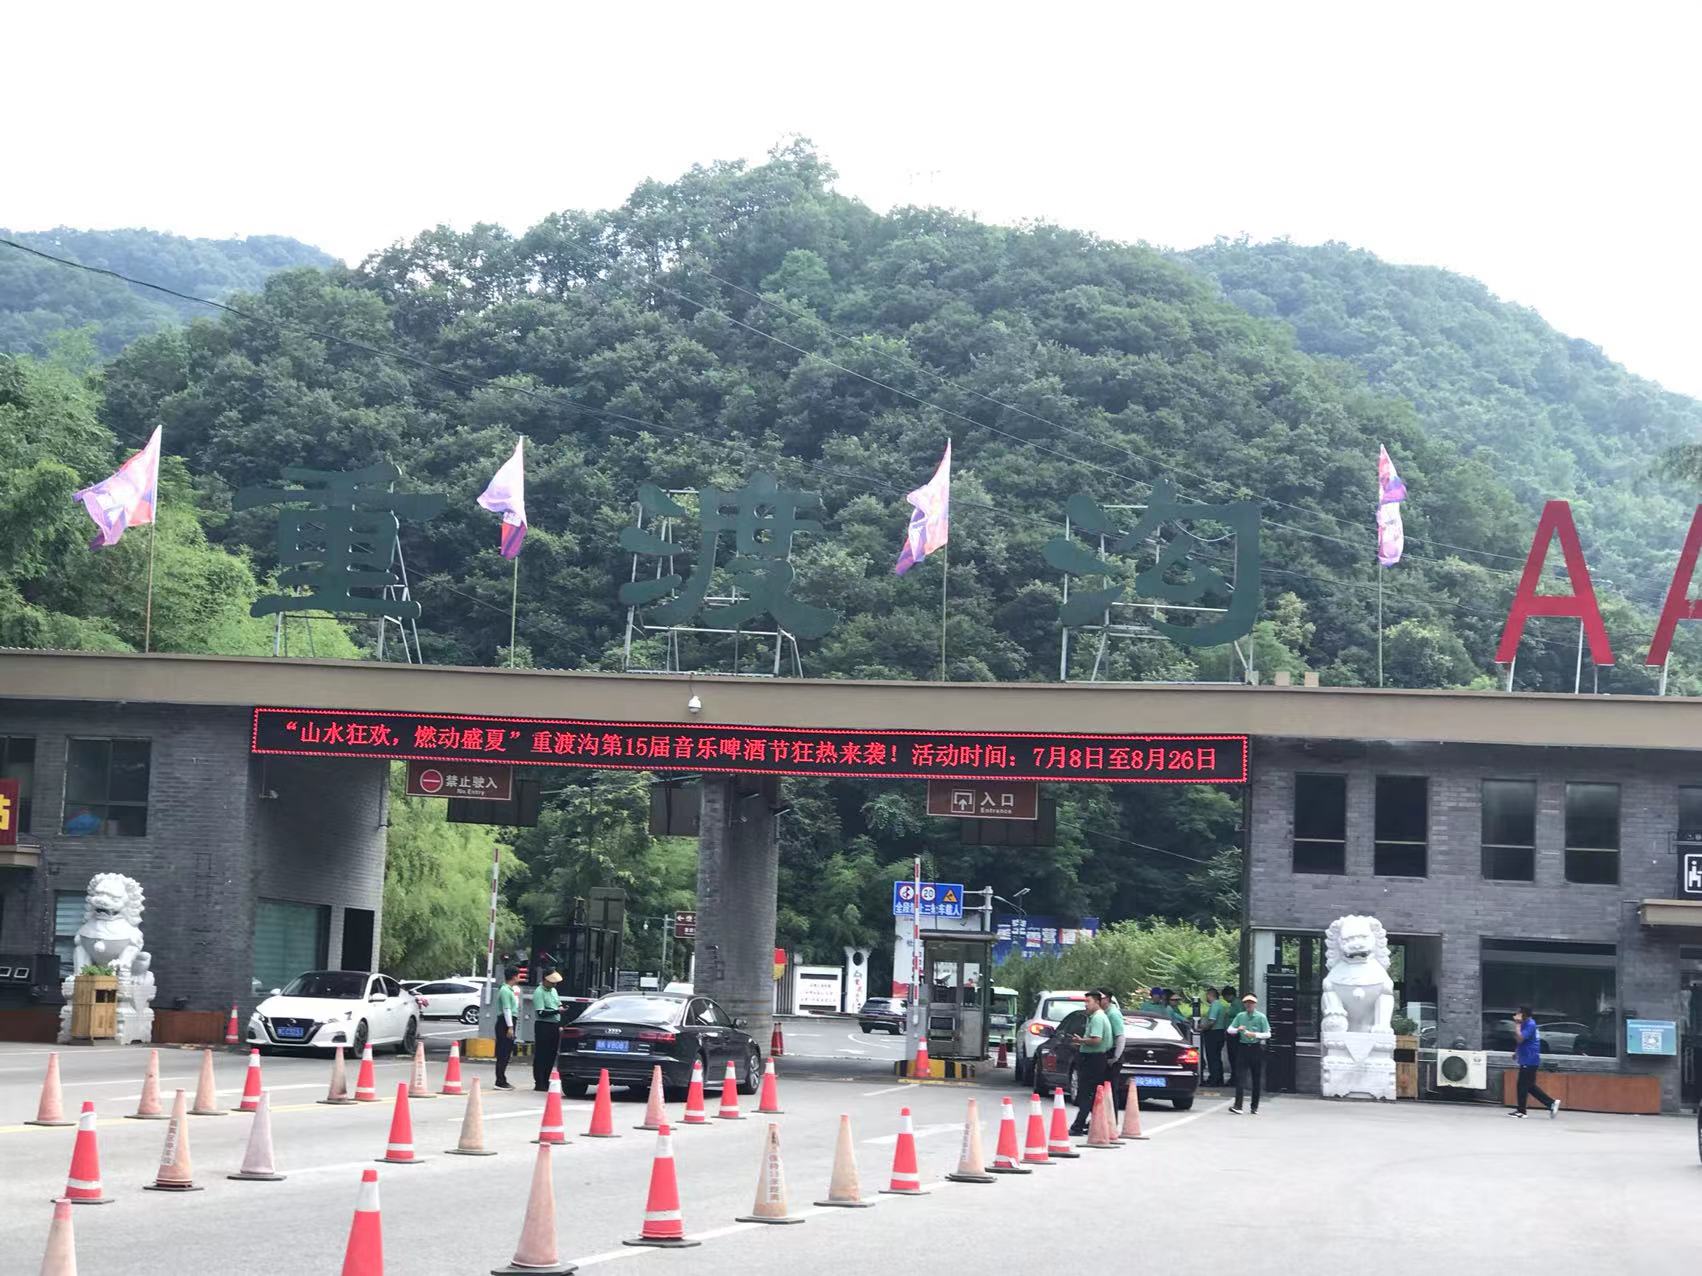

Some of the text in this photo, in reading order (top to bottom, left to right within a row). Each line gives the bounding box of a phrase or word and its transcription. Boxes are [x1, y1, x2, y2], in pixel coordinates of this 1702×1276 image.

[445, 774, 498, 789] 禁止驶入
[980, 791, 1014, 807] 入口
[923, 889, 934, 898] 20
